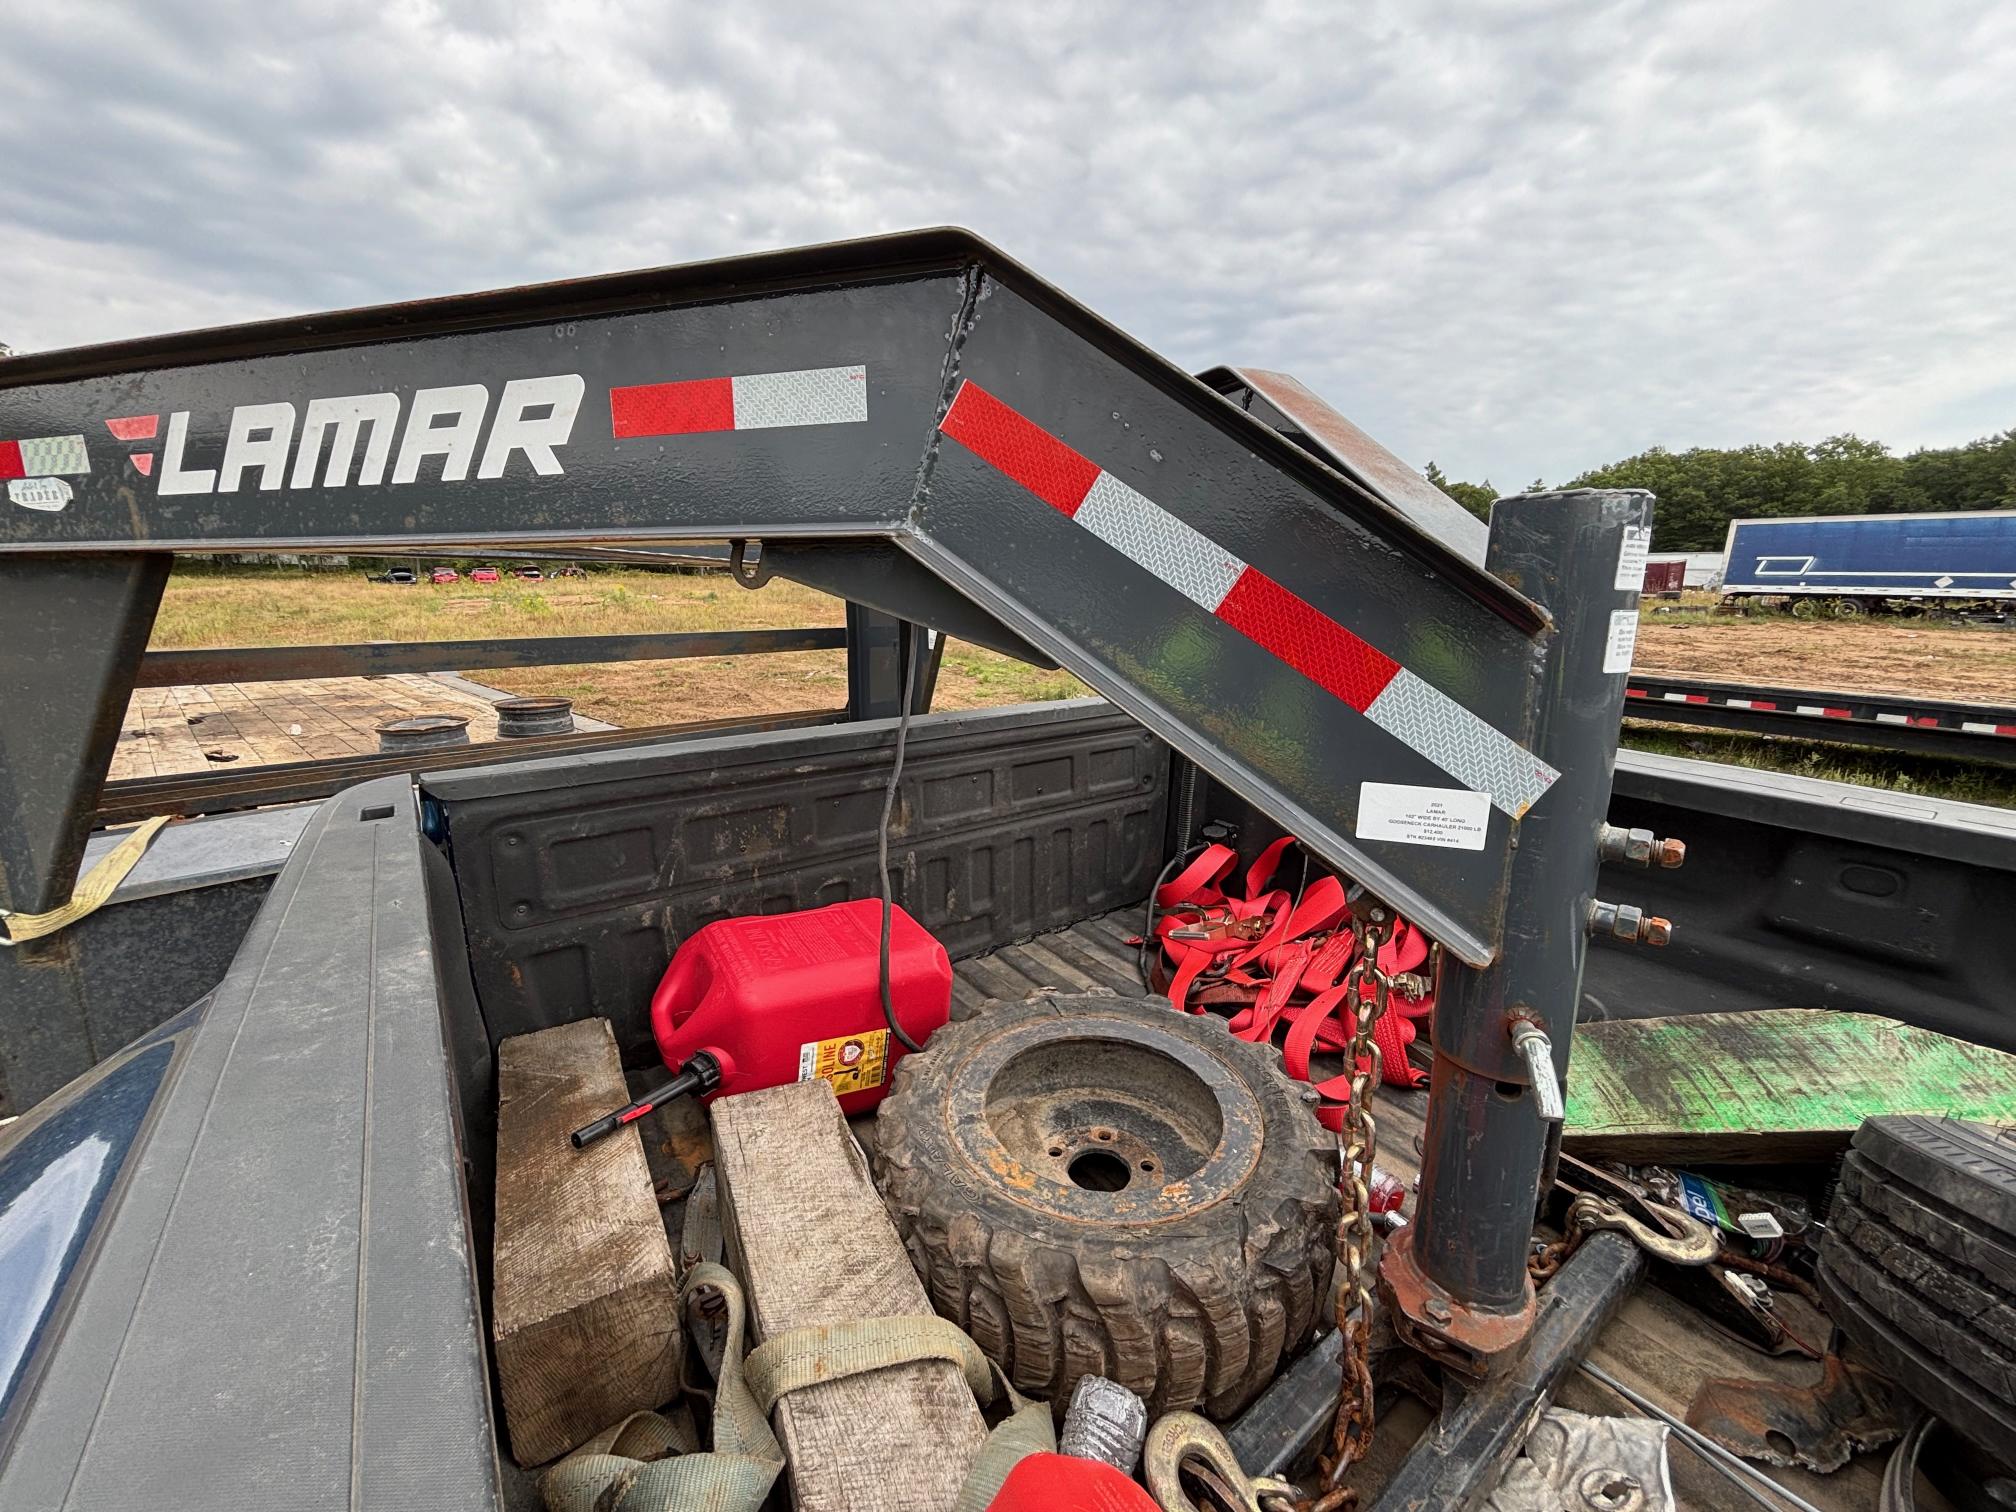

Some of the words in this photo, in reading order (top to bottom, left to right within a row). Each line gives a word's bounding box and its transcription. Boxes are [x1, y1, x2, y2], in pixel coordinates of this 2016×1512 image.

[158, 374, 585, 495] LAMAR
[821, 1043, 837, 1082] SOLINE
[1687, 1190, 1715, 1222] pel
